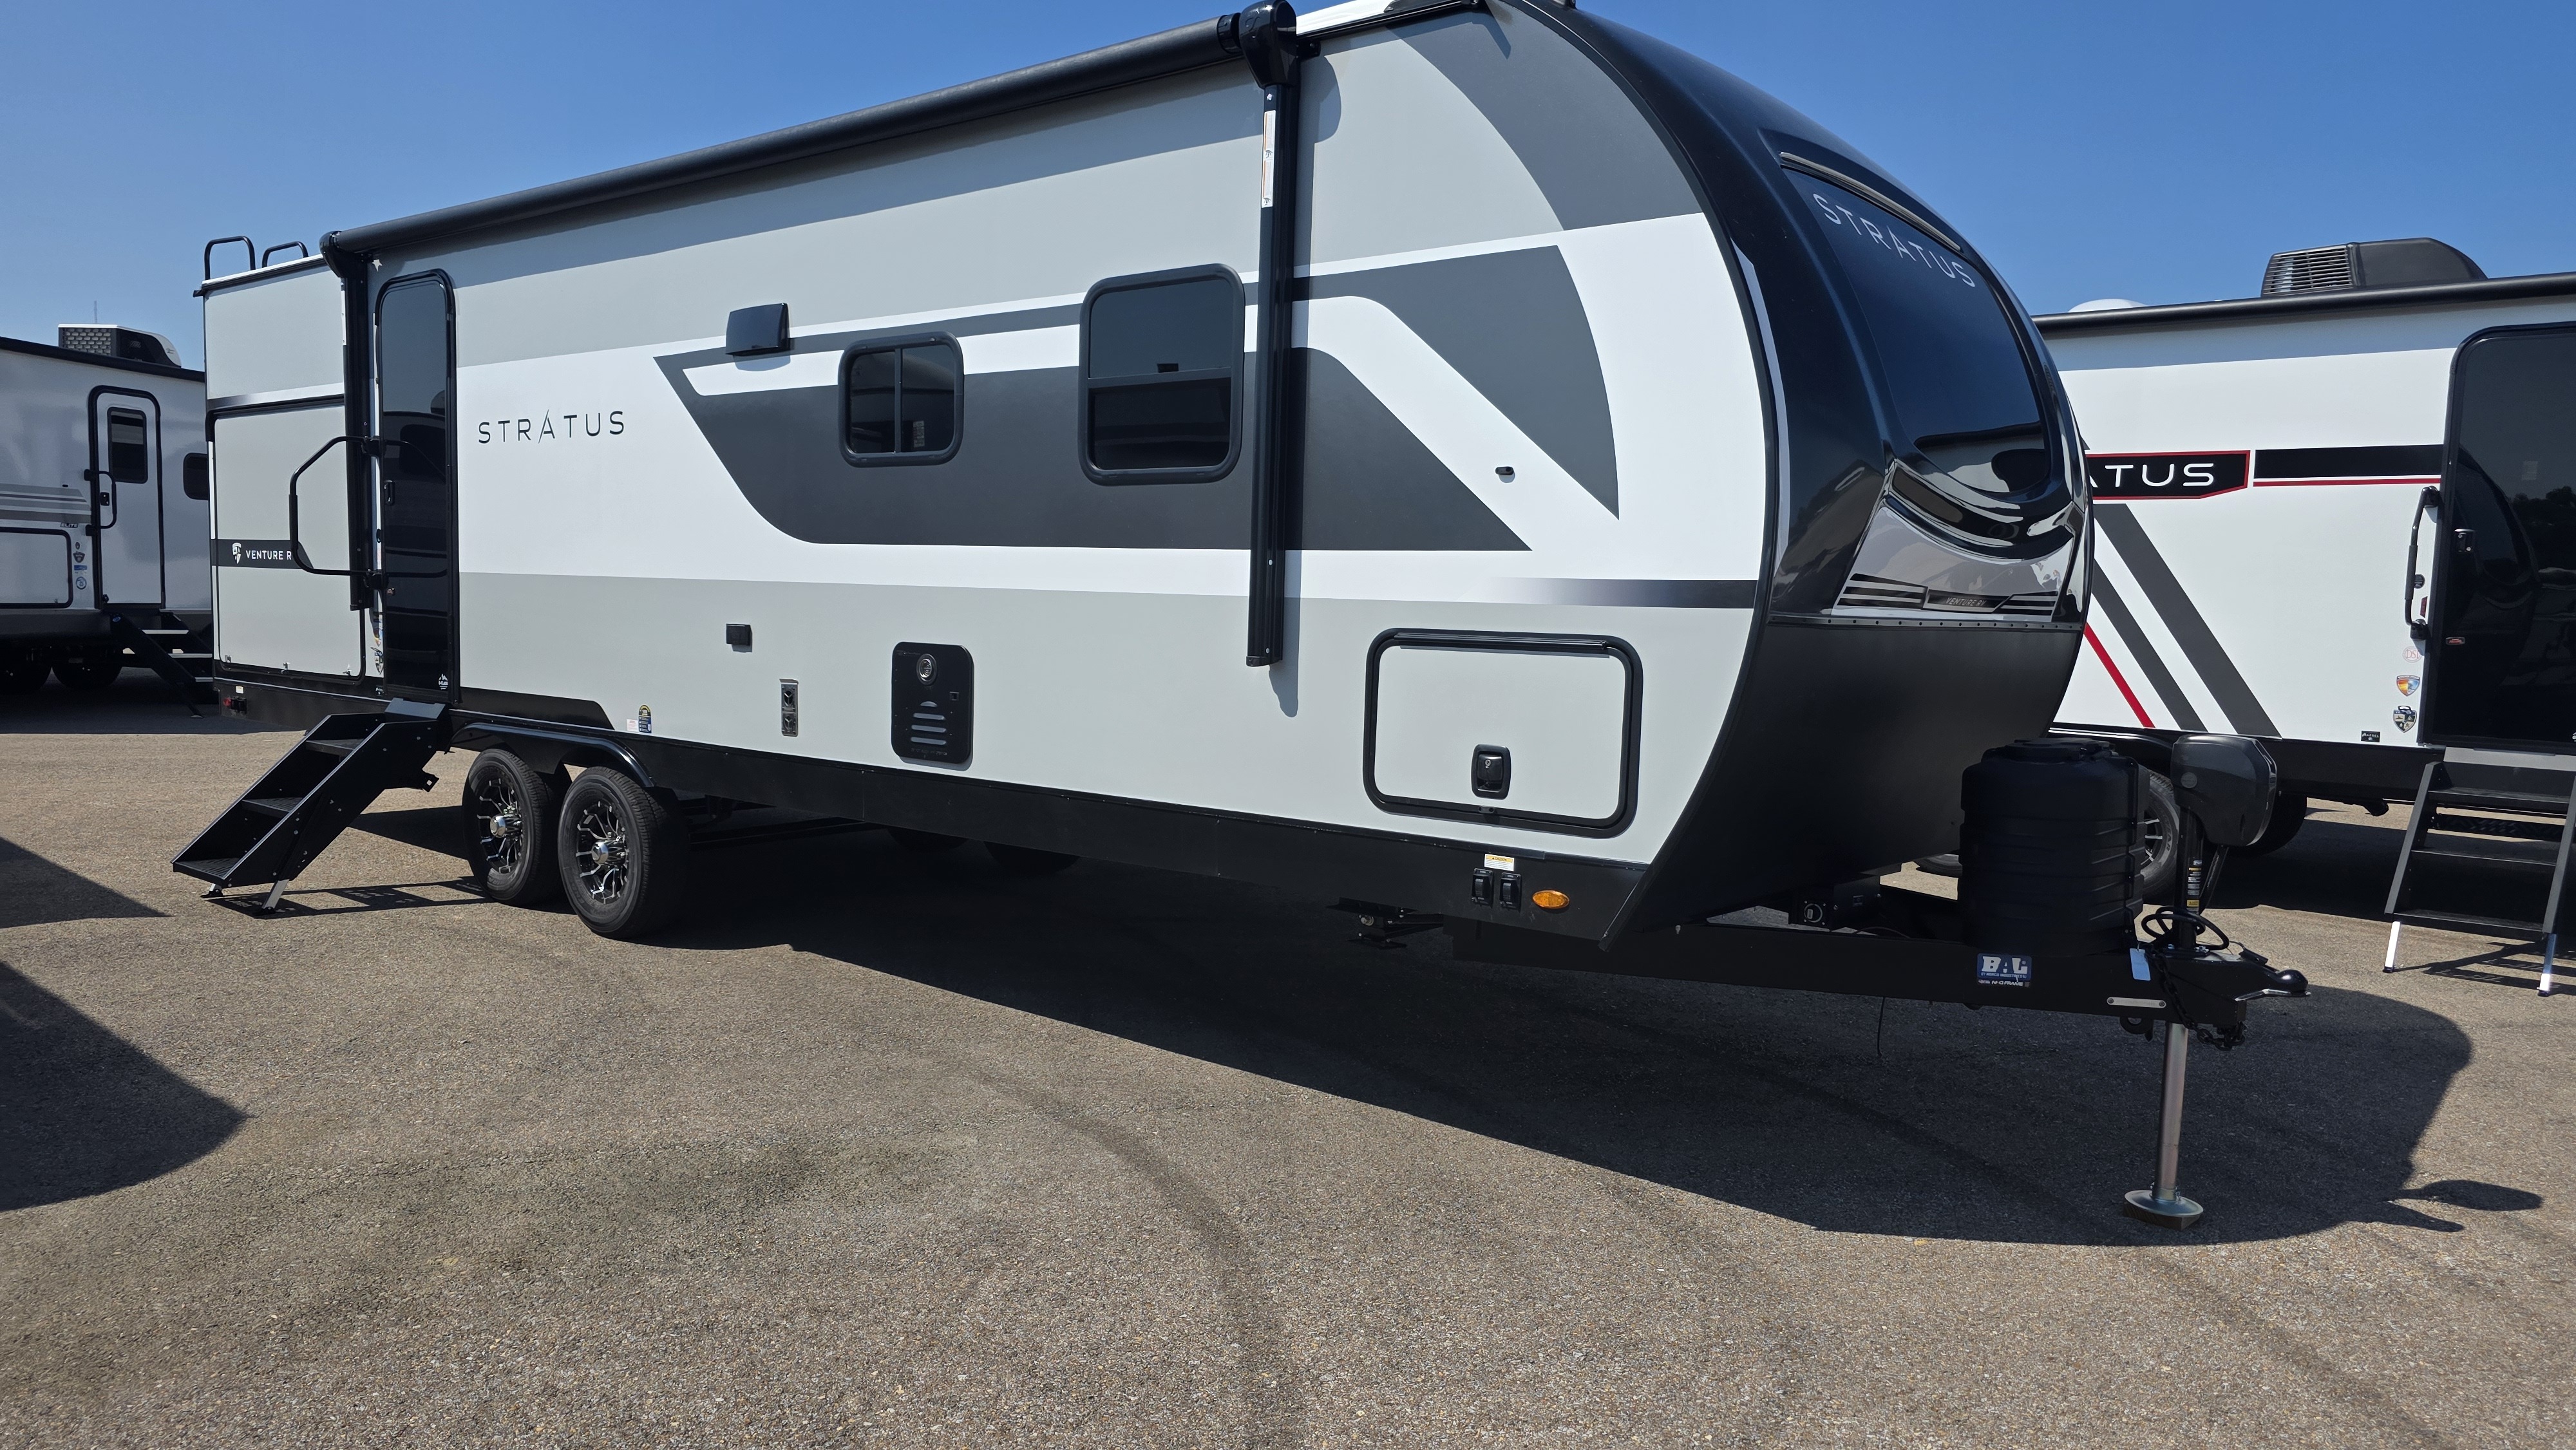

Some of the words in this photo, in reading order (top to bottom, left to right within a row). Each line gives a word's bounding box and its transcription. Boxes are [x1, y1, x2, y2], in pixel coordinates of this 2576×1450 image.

[1813, 193, 1975, 288] STRATUS
[478, 409, 625, 444] STRATUS
[245, 550, 283, 560] VENTURE
[1946, 597, 1976, 606] VENTURE
[1982, 956, 2028, 974] BAL
